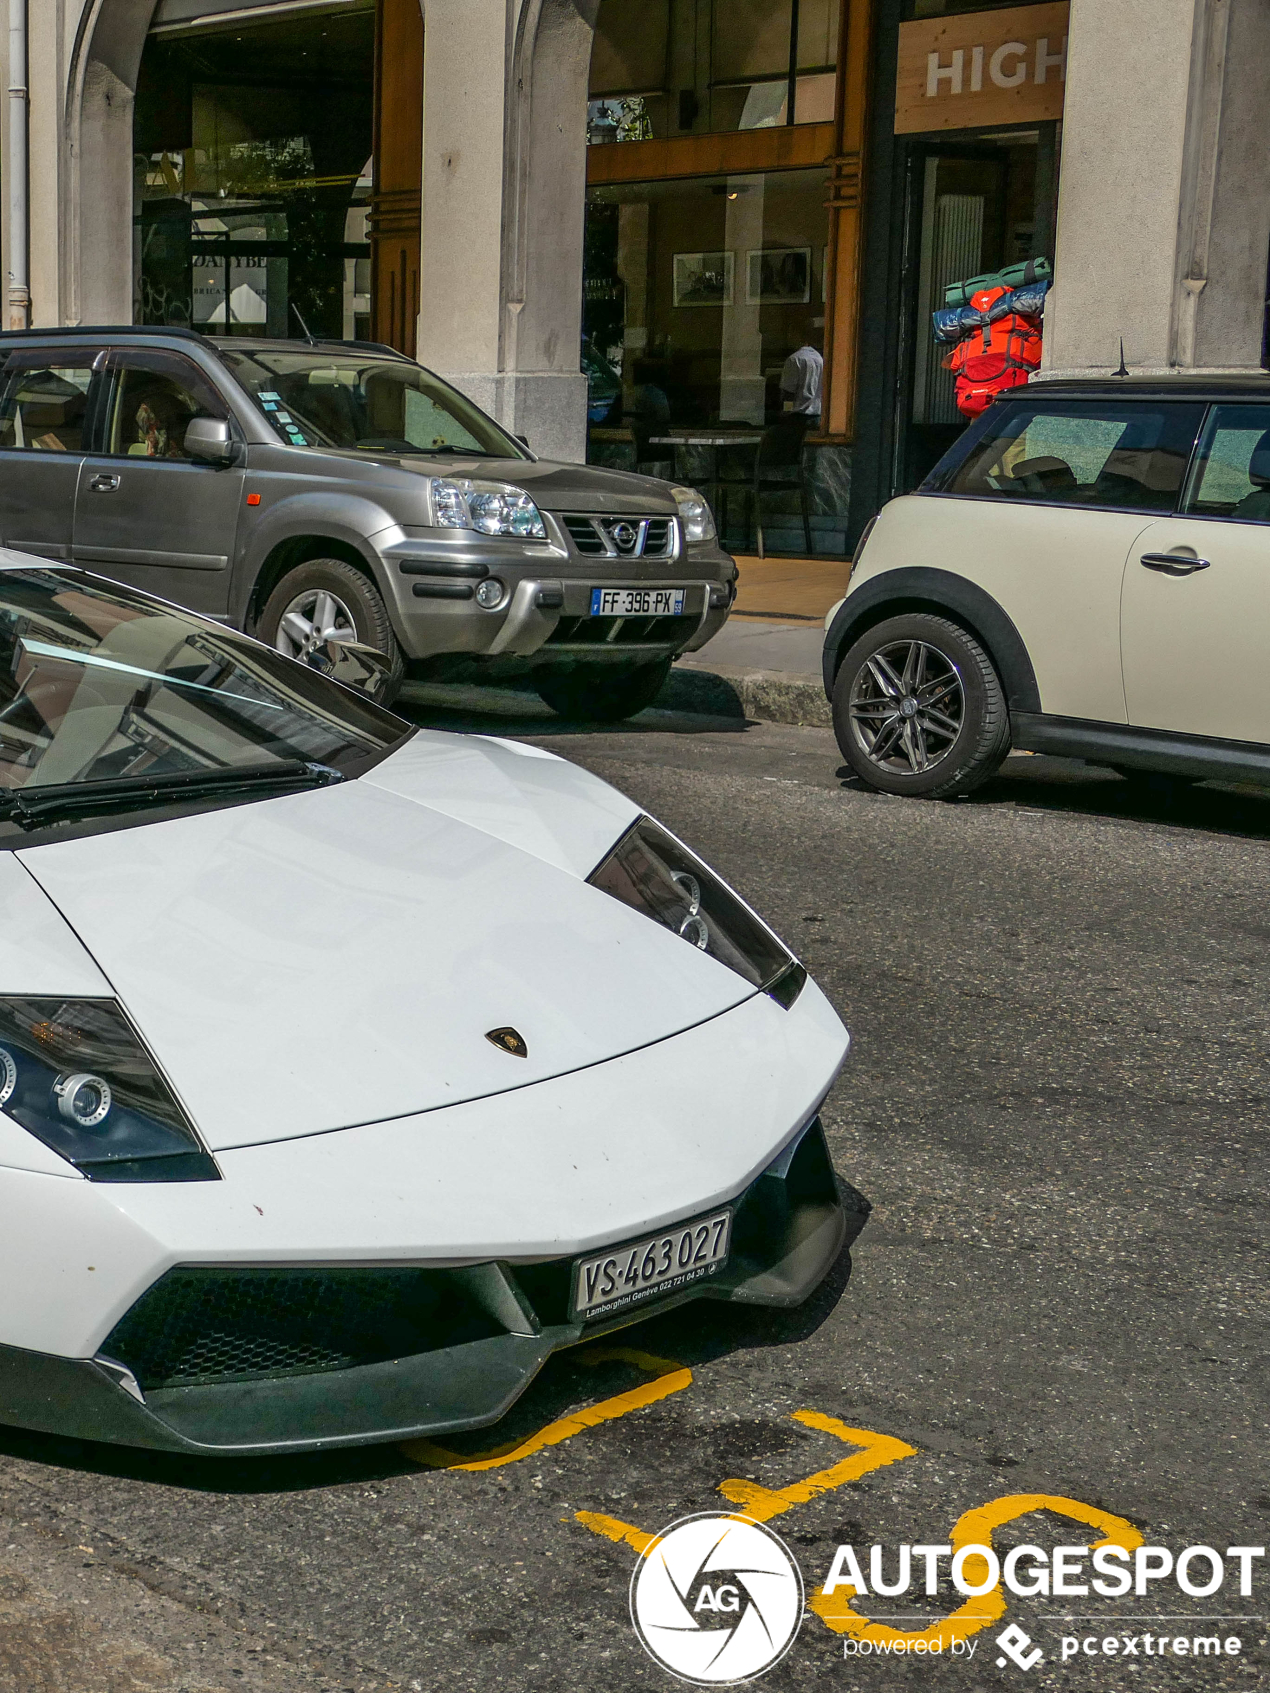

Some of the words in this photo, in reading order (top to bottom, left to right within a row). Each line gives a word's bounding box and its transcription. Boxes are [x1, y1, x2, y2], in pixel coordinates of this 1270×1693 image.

[927, 36, 1068, 97] HIGH
[586, 1294, 631, 1318] Lamborghini
[659, 1280, 672, 1291] 022
[673, 1275, 685, 1286] 721
[686, 1271, 695, 1281] 04
